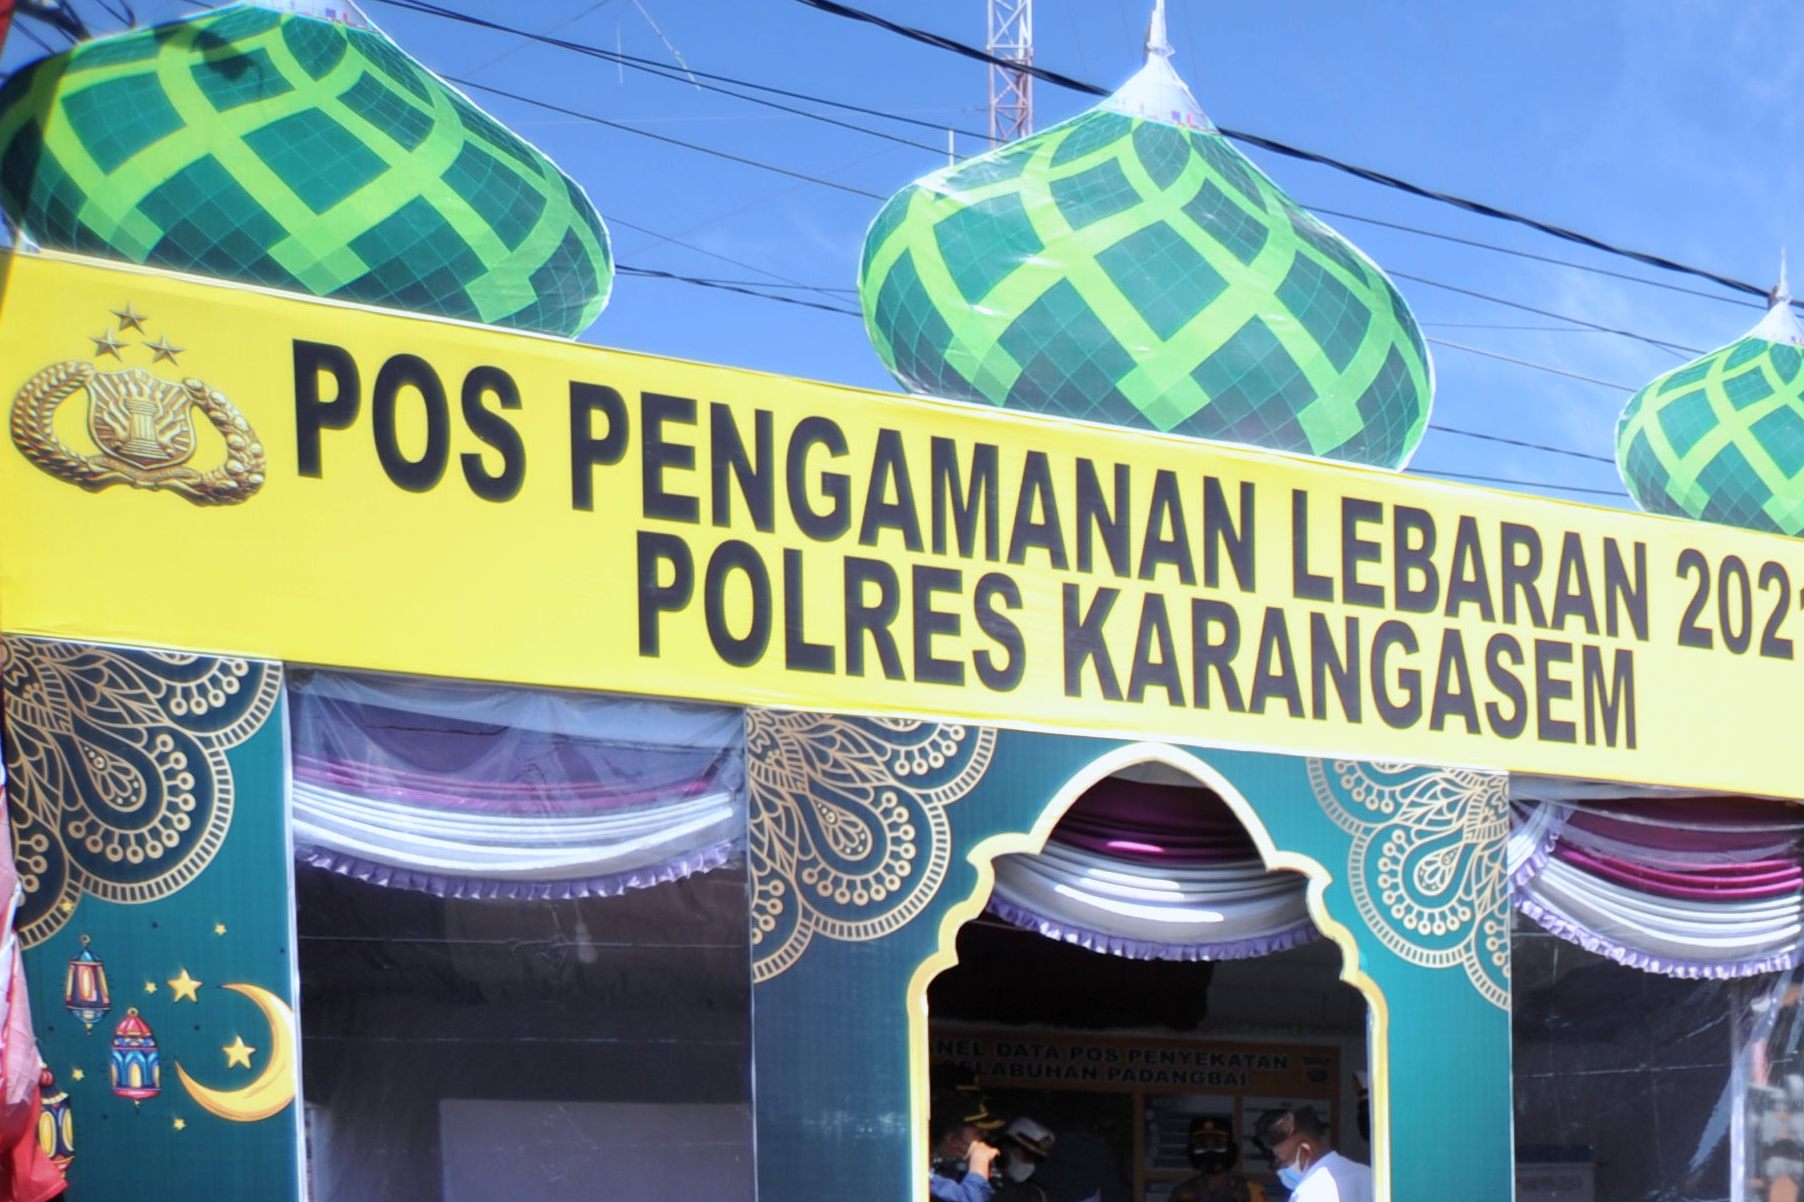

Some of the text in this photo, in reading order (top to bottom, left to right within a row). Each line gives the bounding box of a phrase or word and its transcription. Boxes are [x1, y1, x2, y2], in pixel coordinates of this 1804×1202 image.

[293, 340, 525, 502] POS
[570, 381, 1255, 591] PENGAMANAN
[1292, 489, 1648, 639] LEBARAN
[637, 531, 1637, 749] POLRES KARANGASEM
[997, 1042, 1060, 1059] DATA
[1070, 1046, 1120, 1063] POS
[1129, 1049, 1289, 1070] PENYEKATAN
[1107, 1067, 1248, 1087] PADANGBAI
